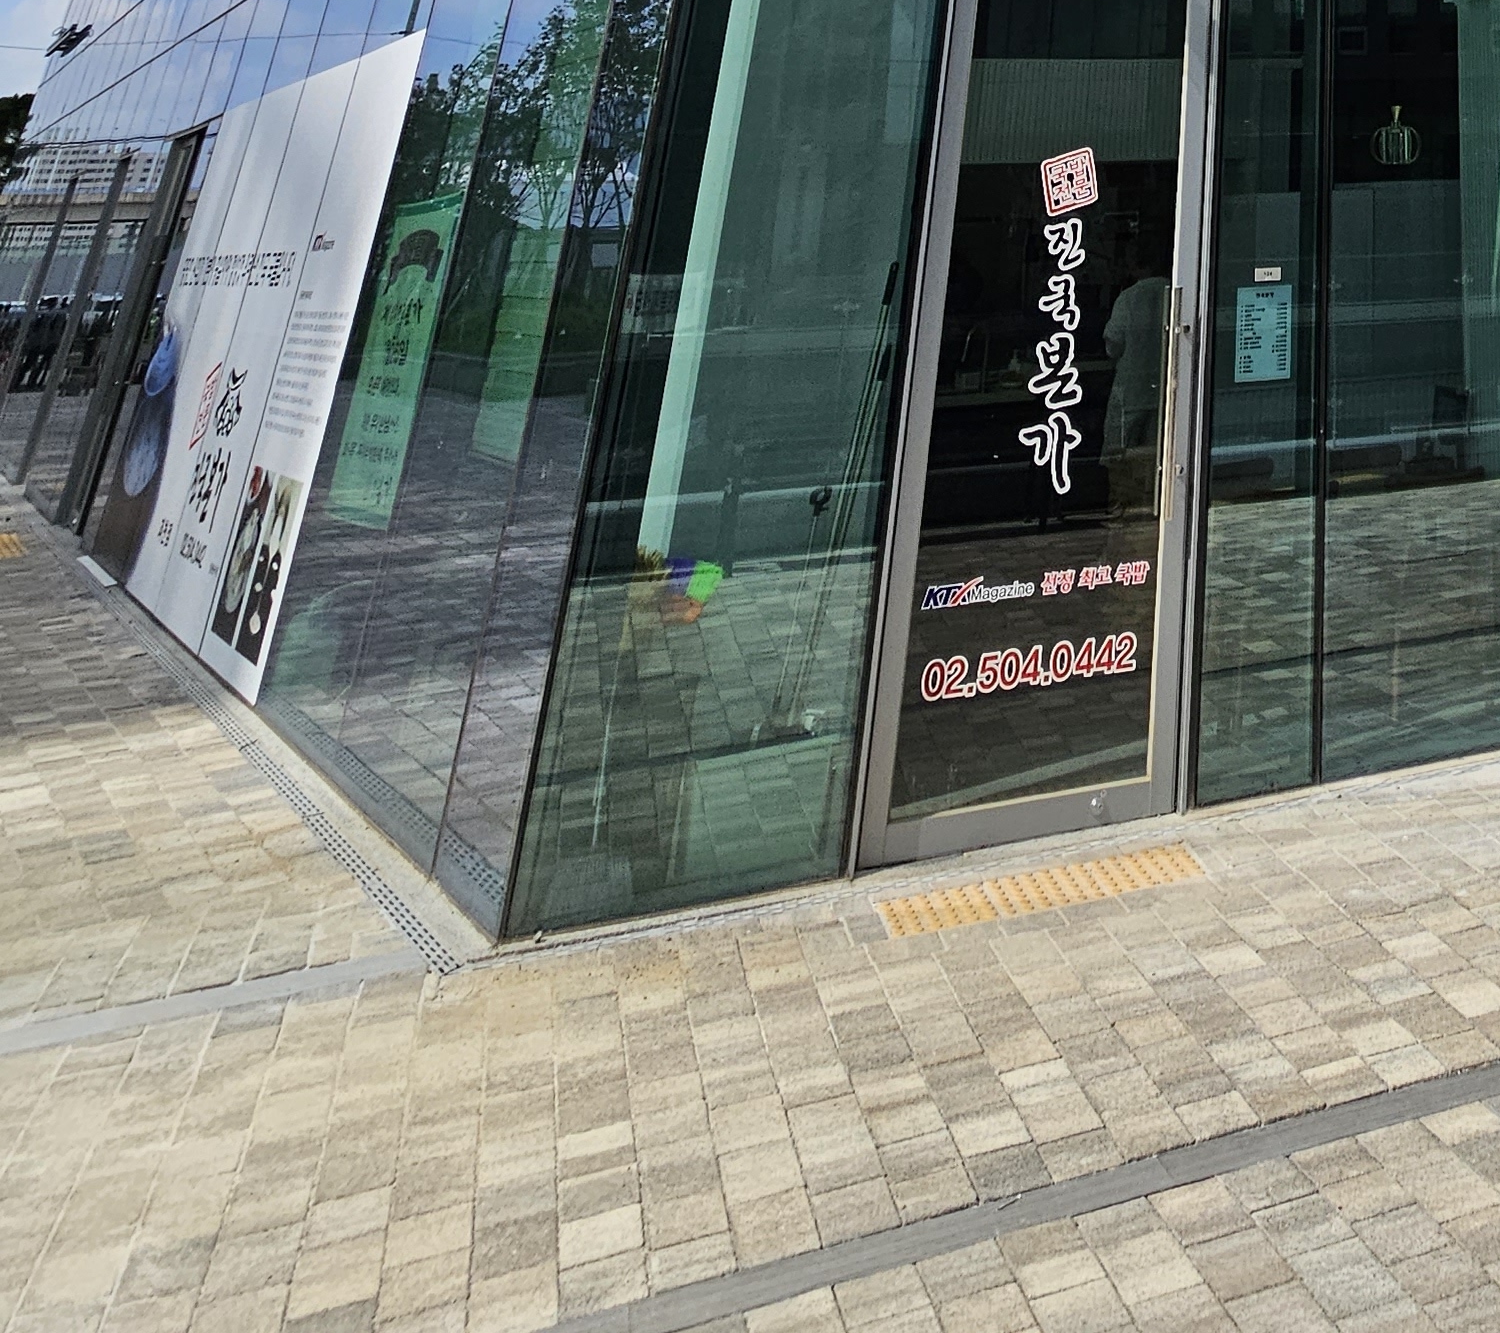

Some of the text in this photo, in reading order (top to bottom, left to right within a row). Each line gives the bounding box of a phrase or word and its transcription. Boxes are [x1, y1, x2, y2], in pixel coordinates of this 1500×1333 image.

[1050, 155, 1088, 184] 국밥
[1052, 178, 1091, 202] 전문
[1019, 218, 1086, 495] 진국본가
[1040, 568, 1077, 596] 선정
[1078, 565, 1112, 591] 최고
[1114, 560, 1151, 586] 국밥
[920, 631, 1138, 702] 02.504.0442
